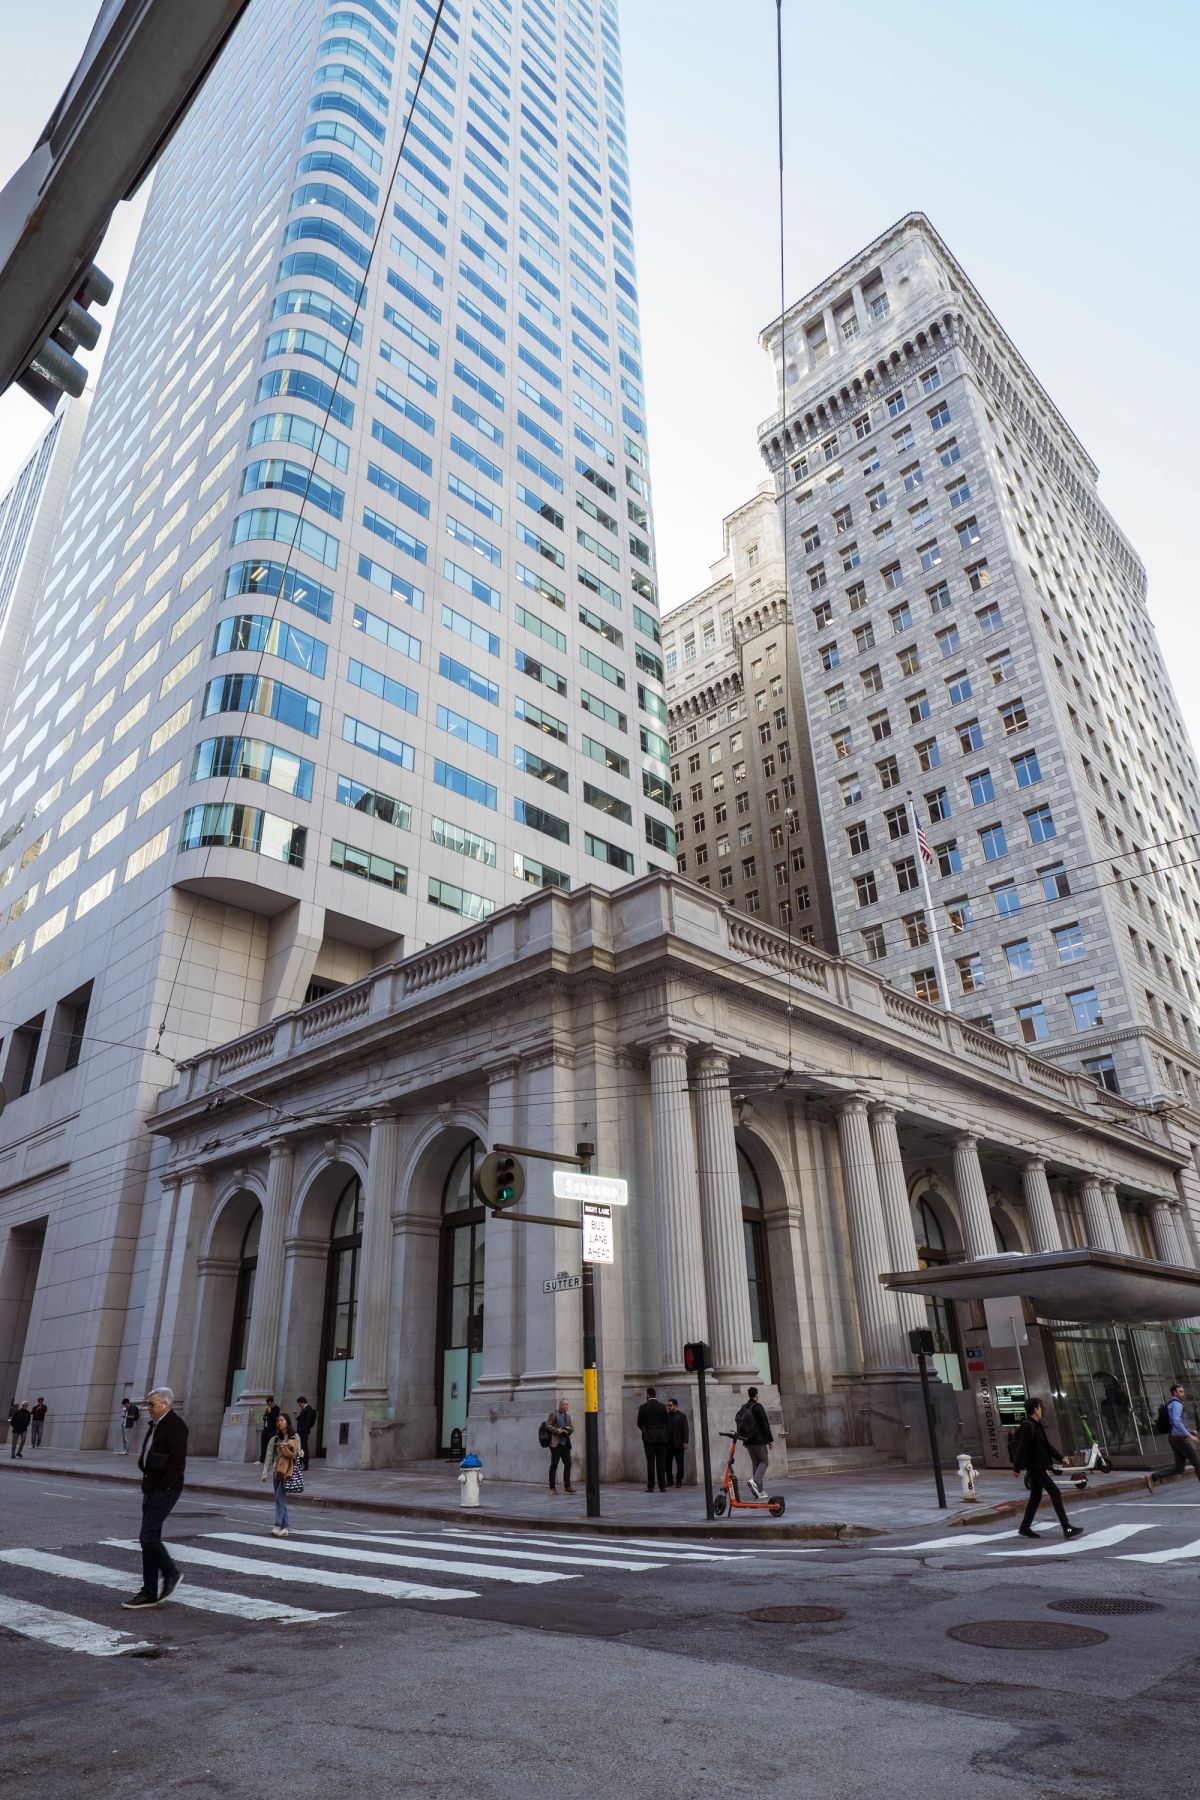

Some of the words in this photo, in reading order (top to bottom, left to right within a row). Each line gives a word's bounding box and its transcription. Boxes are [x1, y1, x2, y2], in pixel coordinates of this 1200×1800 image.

[598, 1207, 610, 1216] LANE
[591, 1220, 605, 1231] BUS
[589, 1233, 608, 1245] LANE
[588, 1247, 610, 1259] AHEAD
[545, 1277, 580, 1291] SUTTER
[979, 1378, 1000, 1458] MONTGOMERY
